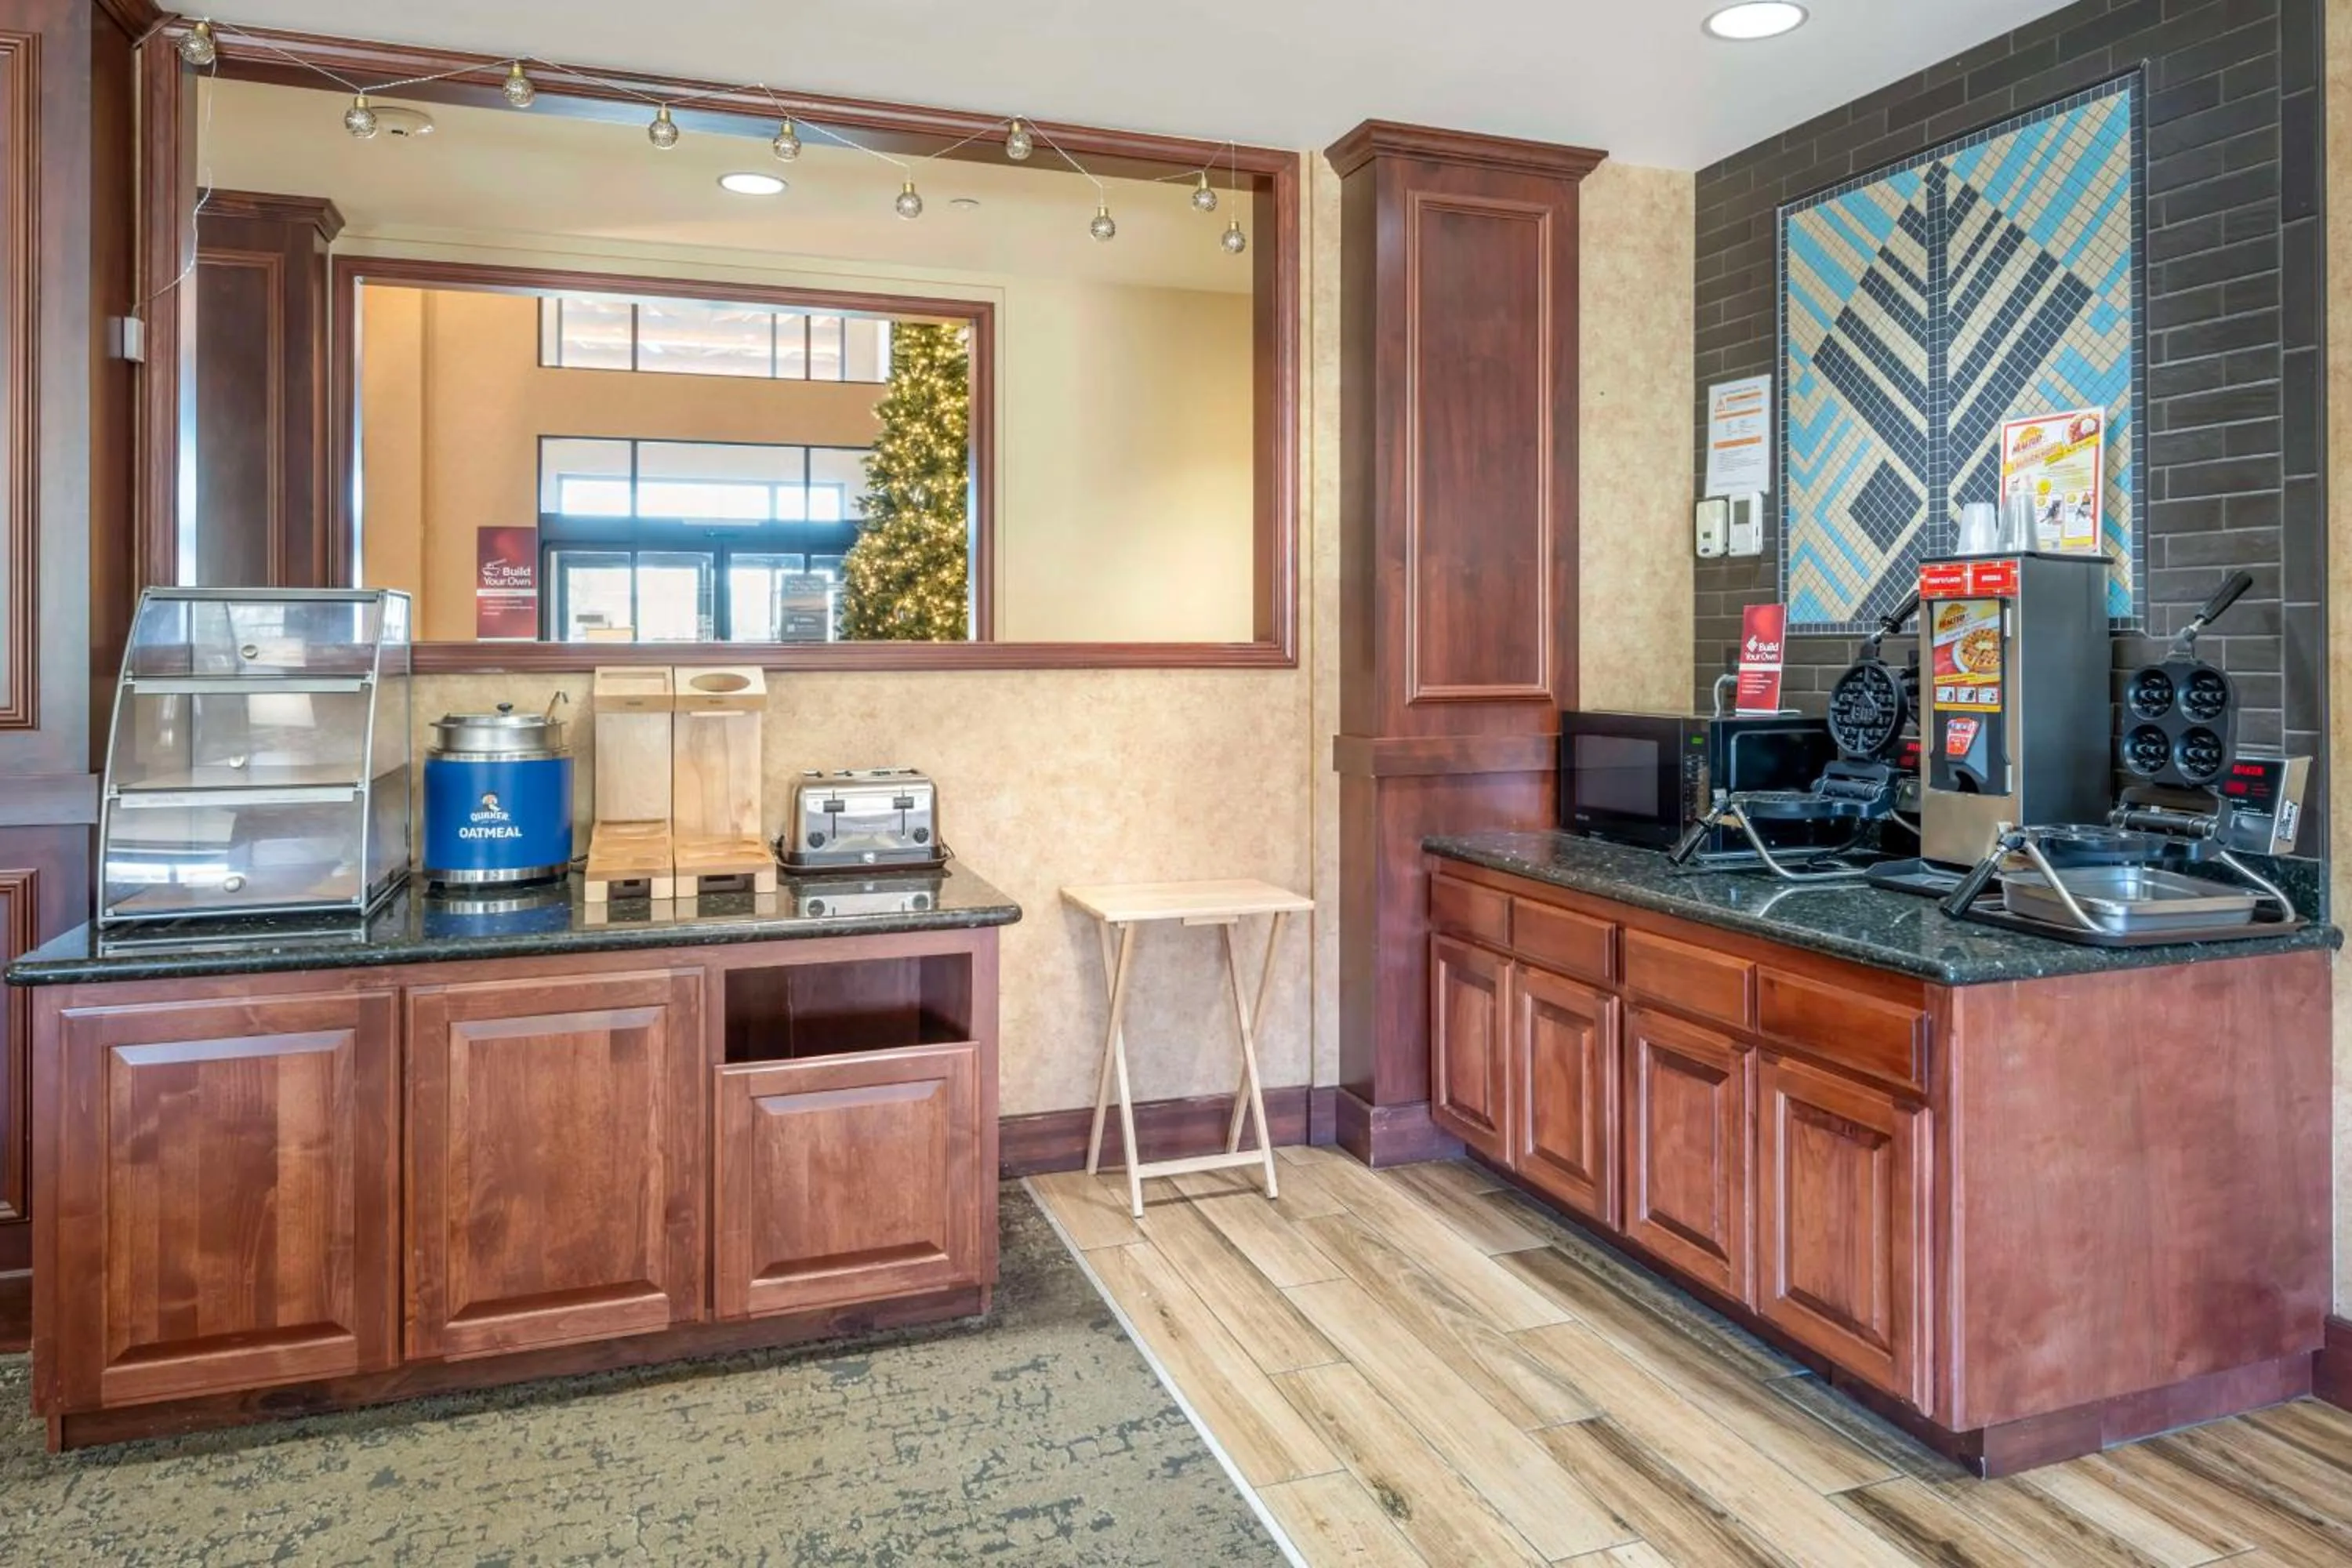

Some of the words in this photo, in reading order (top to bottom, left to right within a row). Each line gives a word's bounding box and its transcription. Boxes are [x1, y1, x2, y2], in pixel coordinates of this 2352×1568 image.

[503, 565, 531, 576] Build
[484, 577, 506, 586] Your
[507, 577, 532, 586] Own
[1759, 642, 1779, 652] Build
[1745, 652, 1760, 661] Your
[1761, 652, 1779, 661] Own
[459, 826, 524, 839] OATMEAL
